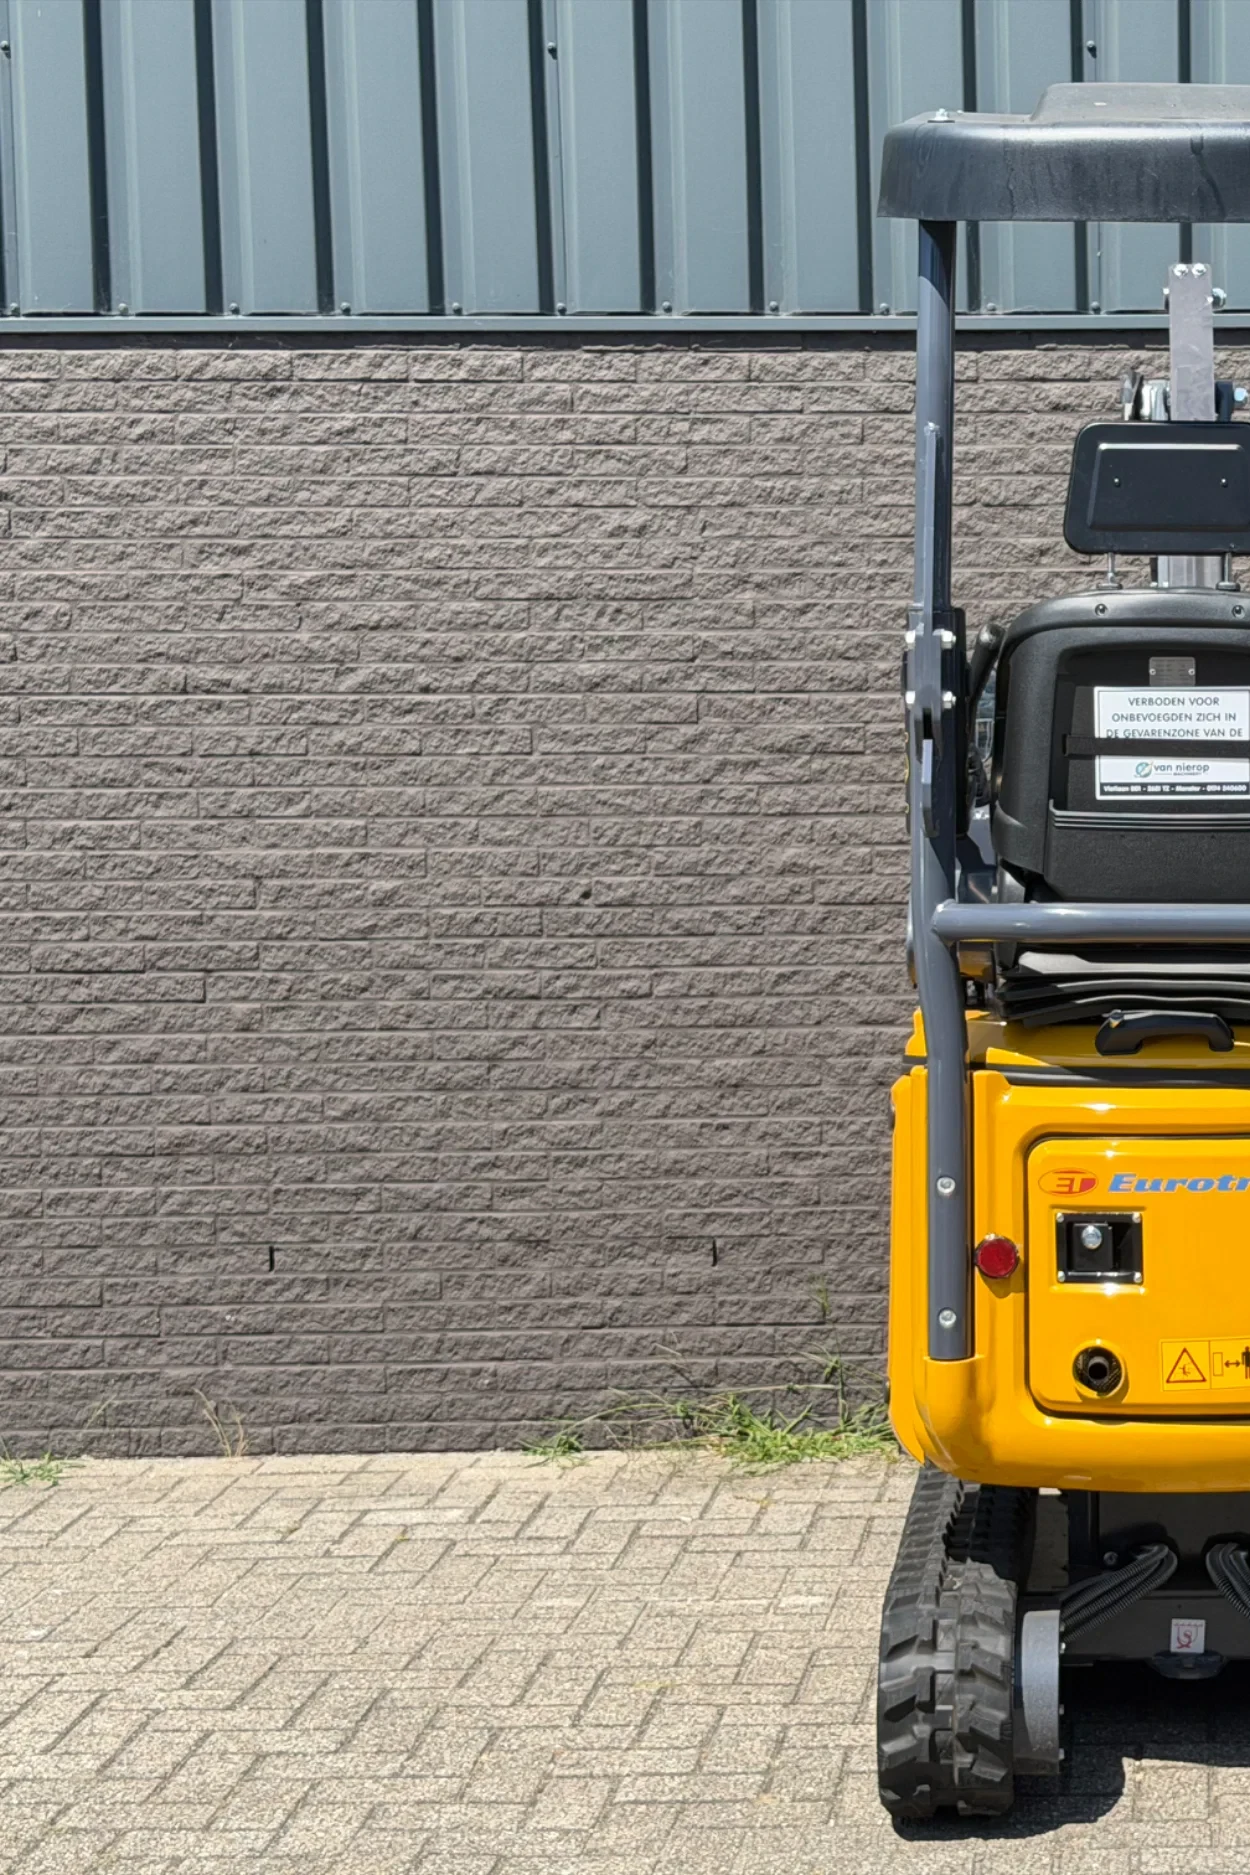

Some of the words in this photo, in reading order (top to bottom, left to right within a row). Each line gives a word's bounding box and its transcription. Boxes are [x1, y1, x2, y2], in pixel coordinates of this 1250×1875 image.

[1128, 696, 1185, 706] VERBODEN
[1189, 696, 1220, 706] VOOR
[1112, 712, 1192, 722] ONBEVOEGDEN
[1196, 712, 1221, 722] ZICH
[1225, 712, 1237, 722] IN
[1106, 728, 1119, 738] DE
[1123, 728, 1200, 738] GEVARENZONE
[1203, 728, 1226, 738] VAN
[1229, 727, 1244, 738] DE
[1154, 763, 1173, 772] van
[1176, 761, 1210, 773] nierop
